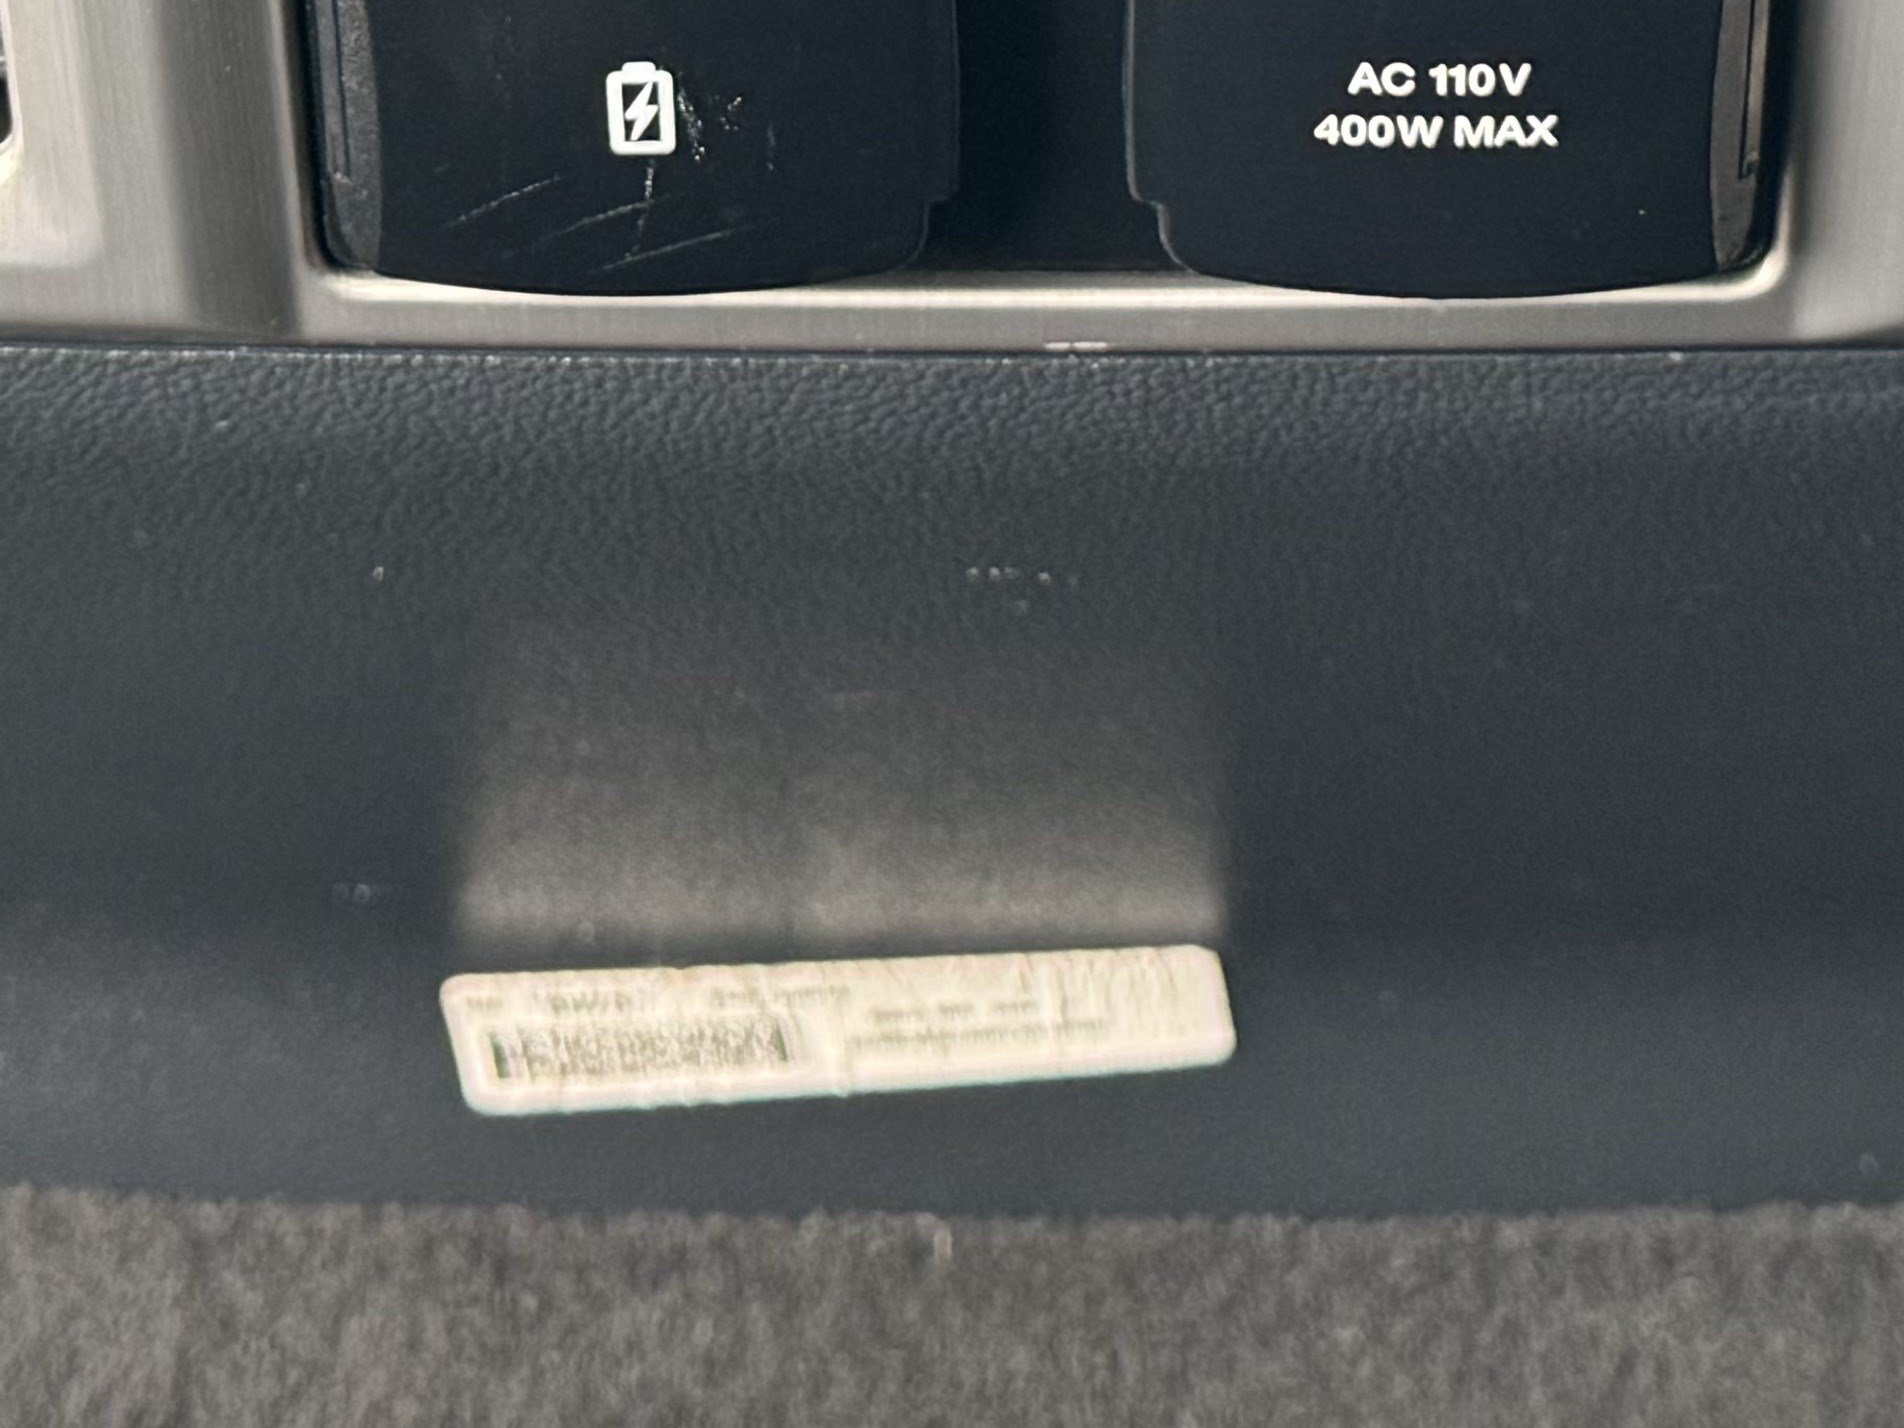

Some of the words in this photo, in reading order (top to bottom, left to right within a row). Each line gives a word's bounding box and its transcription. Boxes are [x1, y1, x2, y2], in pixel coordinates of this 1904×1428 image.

[1347, 61, 1416, 97] AC
[1428, 62, 1532, 97] 110V
[1313, 113, 1444, 148] 400W
[1453, 114, 1559, 148] MAX
